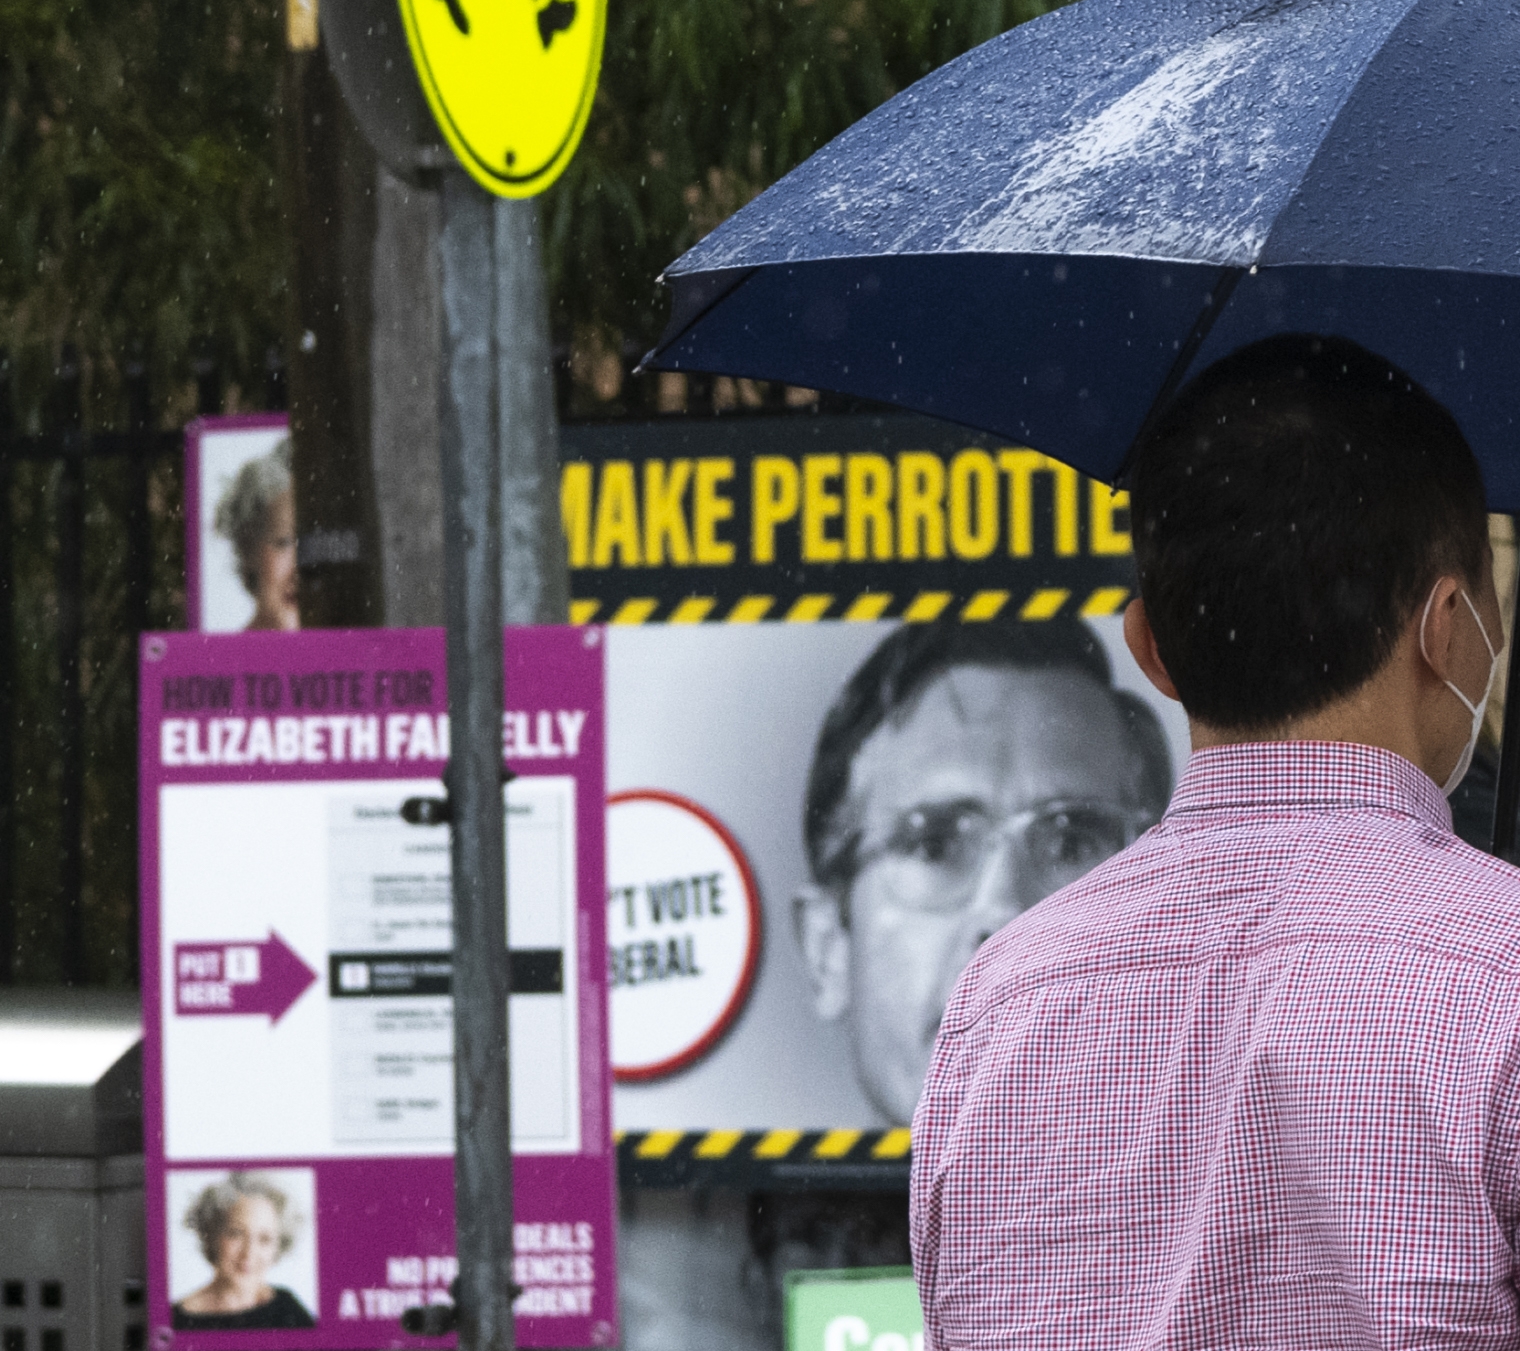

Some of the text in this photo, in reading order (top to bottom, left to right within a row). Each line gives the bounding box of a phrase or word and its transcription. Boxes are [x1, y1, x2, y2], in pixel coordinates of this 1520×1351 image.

[162, 669, 434, 711] HOW TO VOTE FOR
[161, 714, 378, 766] ELIZABETH
[646, 871, 726, 924] VOTE
